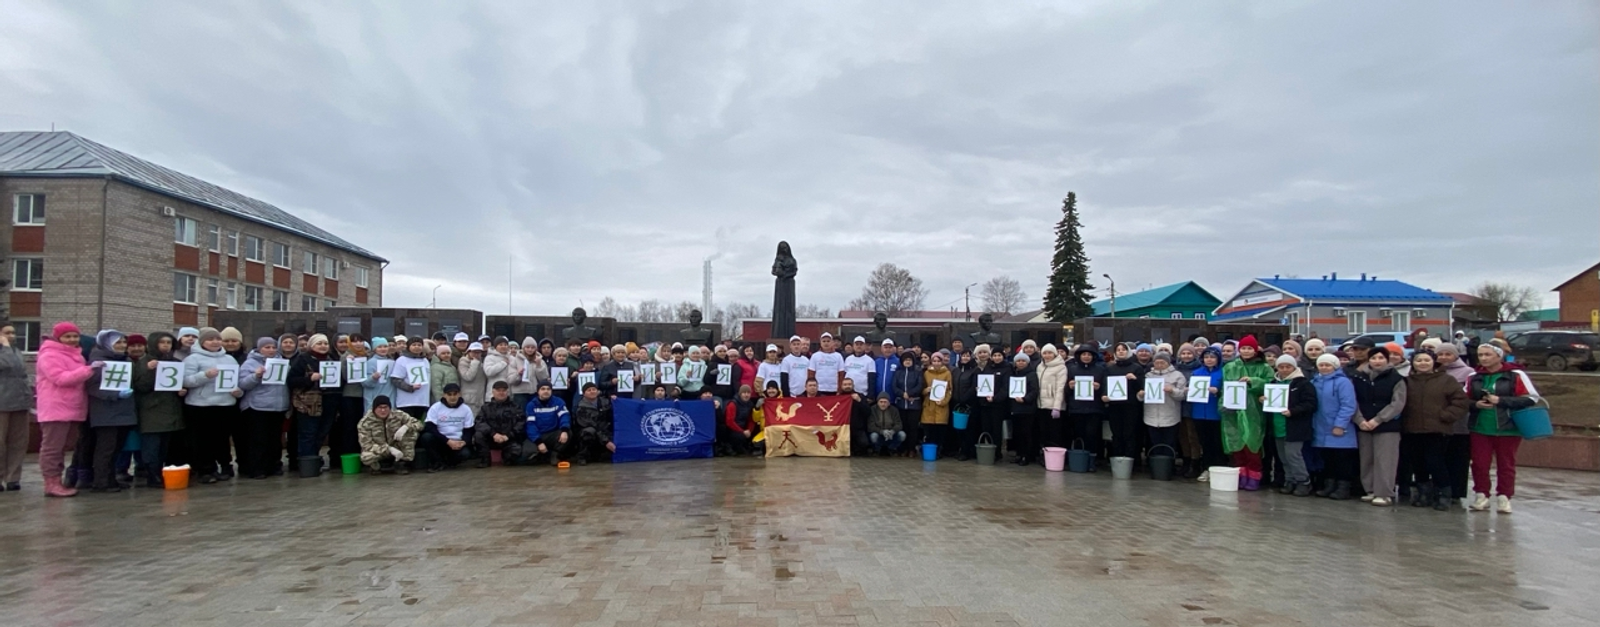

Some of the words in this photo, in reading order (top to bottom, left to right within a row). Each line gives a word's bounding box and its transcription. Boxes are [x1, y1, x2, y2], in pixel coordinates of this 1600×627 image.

[162, 366, 177, 387] З
[218, 371, 235, 389] Е
[262, 363, 284, 381] Л
[322, 361, 338, 385] Ё
[349, 361, 365, 379] Н
[410, 367, 424, 382] Я
[552, 371, 567, 387] А
[619, 374, 633, 389] К
[641, 367, 655, 383] И
[663, 367, 674, 381] Р
[690, 364, 702, 378] И
[718, 367, 730, 382] Я
[933, 383, 943, 398] С
[979, 377, 993, 392] А
[1011, 379, 1025, 394] Д
[1076, 379, 1092, 396] П
[1110, 380, 1126, 397] А
[1147, 382, 1163, 400] М
[1190, 380, 1208, 398] Я
[1227, 385, 1246, 405] Т
[1264, 388, 1286, 408] И
